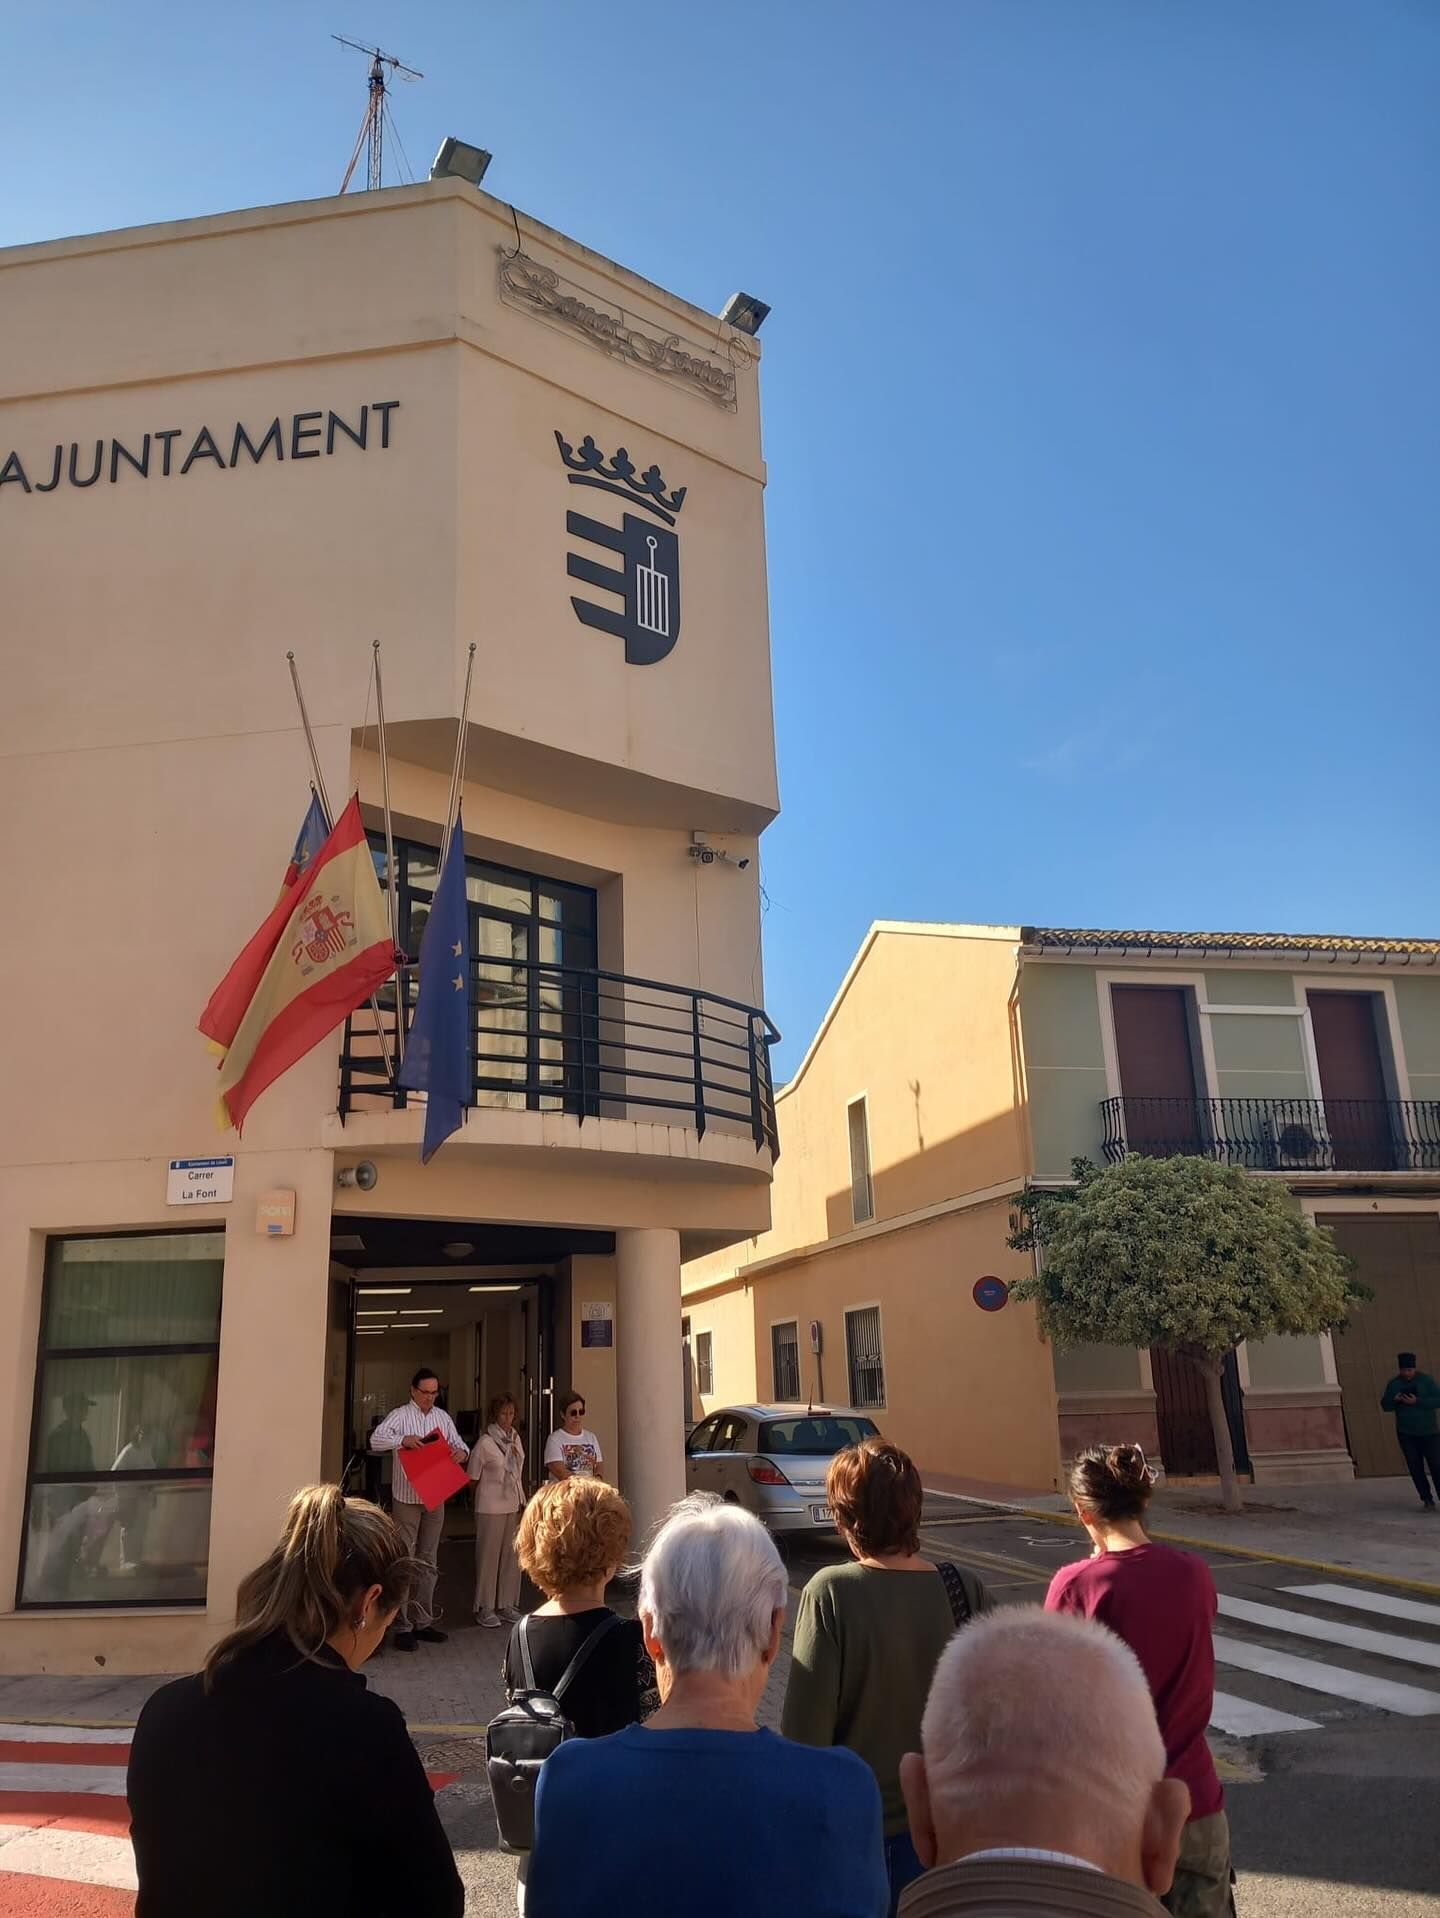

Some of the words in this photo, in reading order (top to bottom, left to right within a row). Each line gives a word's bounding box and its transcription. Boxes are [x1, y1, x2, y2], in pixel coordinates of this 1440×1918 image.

[0, 401, 400, 493] AJUNTAMENT
[188, 1171, 214, 1180] Carrer
[182, 1190, 193, 1199] La
[196, 1189, 217, 1198] Font
